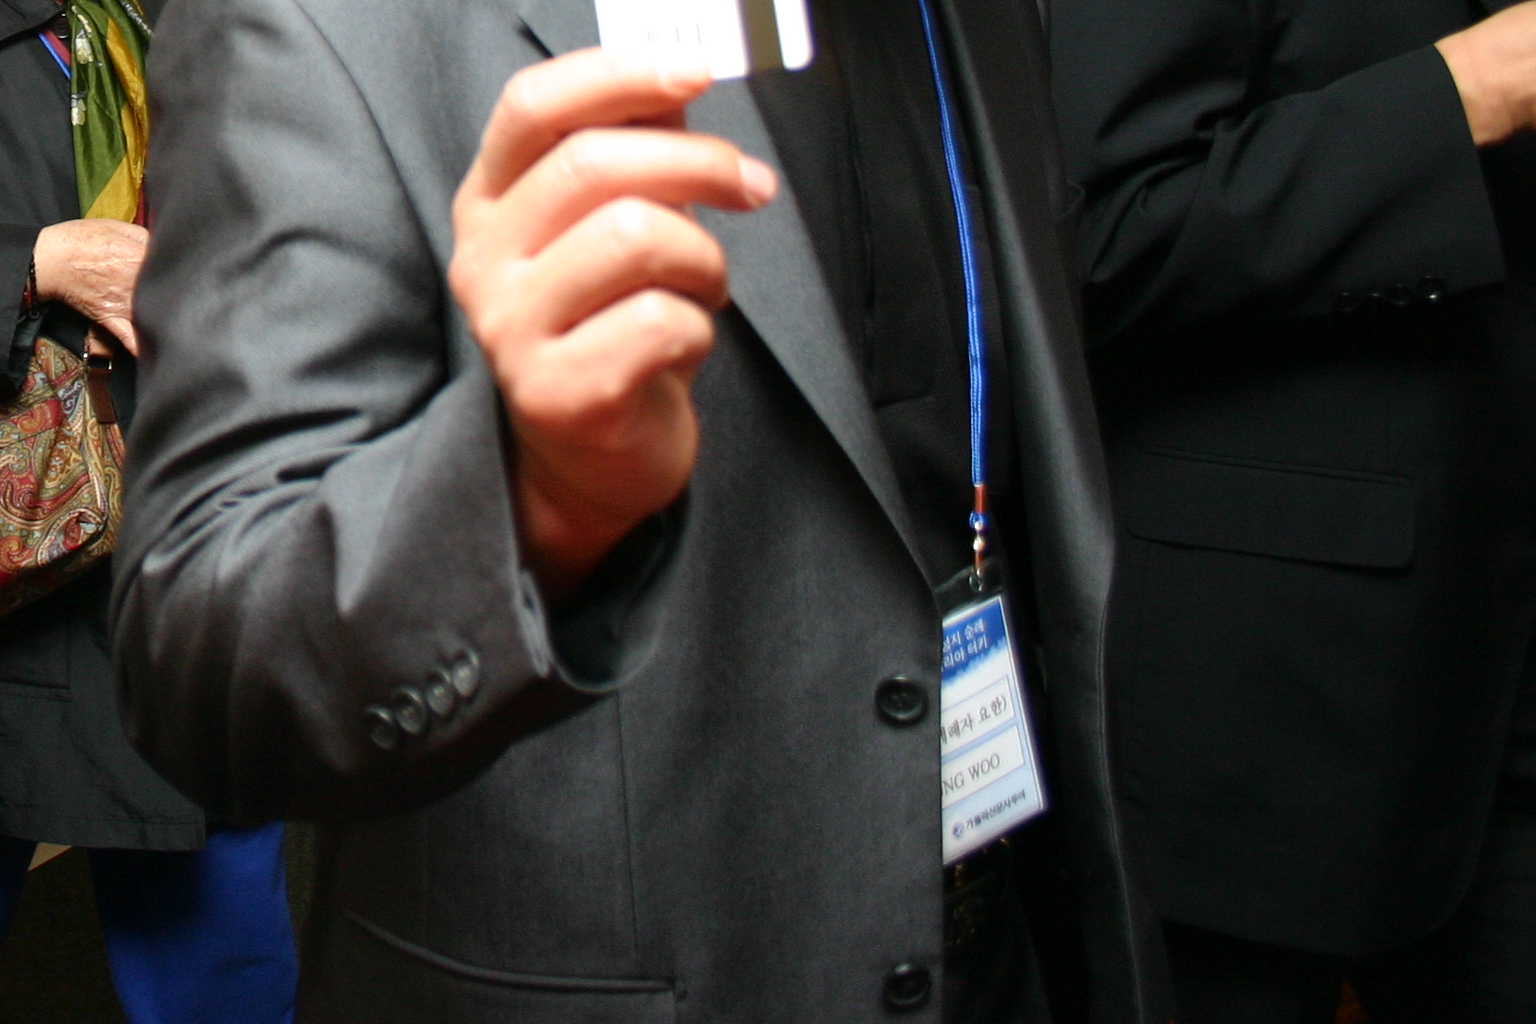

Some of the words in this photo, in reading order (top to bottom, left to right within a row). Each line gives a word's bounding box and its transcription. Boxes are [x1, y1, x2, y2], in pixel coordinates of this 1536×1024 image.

[964, 618, 985, 641] 순례
[941, 646, 965, 672] 리아
[967, 753, 1000, 781] WOO
